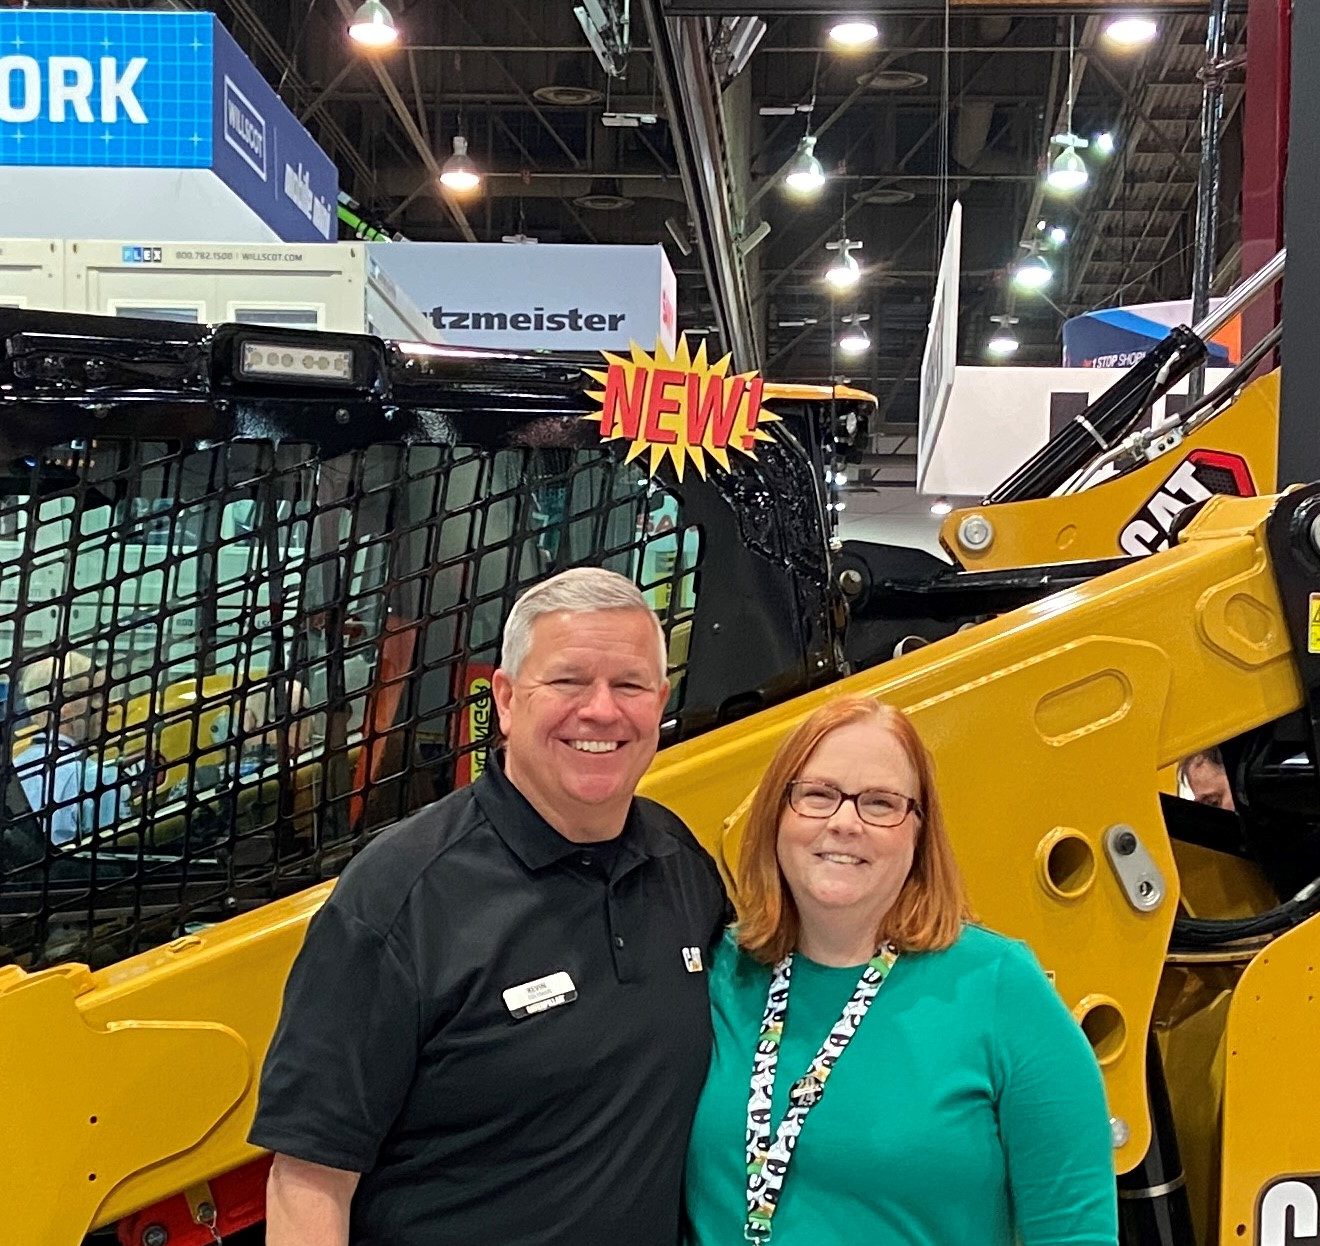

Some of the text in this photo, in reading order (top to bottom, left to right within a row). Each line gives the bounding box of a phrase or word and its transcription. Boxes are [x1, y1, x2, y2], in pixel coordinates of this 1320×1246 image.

[228, 98, 264, 159] WILLSCOT
[122, 245, 163, 263] FLEX
[241, 252, 303, 262] WILLSCOT.COM
[1097, 354, 1118, 369] STOP
[599, 364, 765, 451] NEW!
[1121, 460, 1214, 557] CAT
